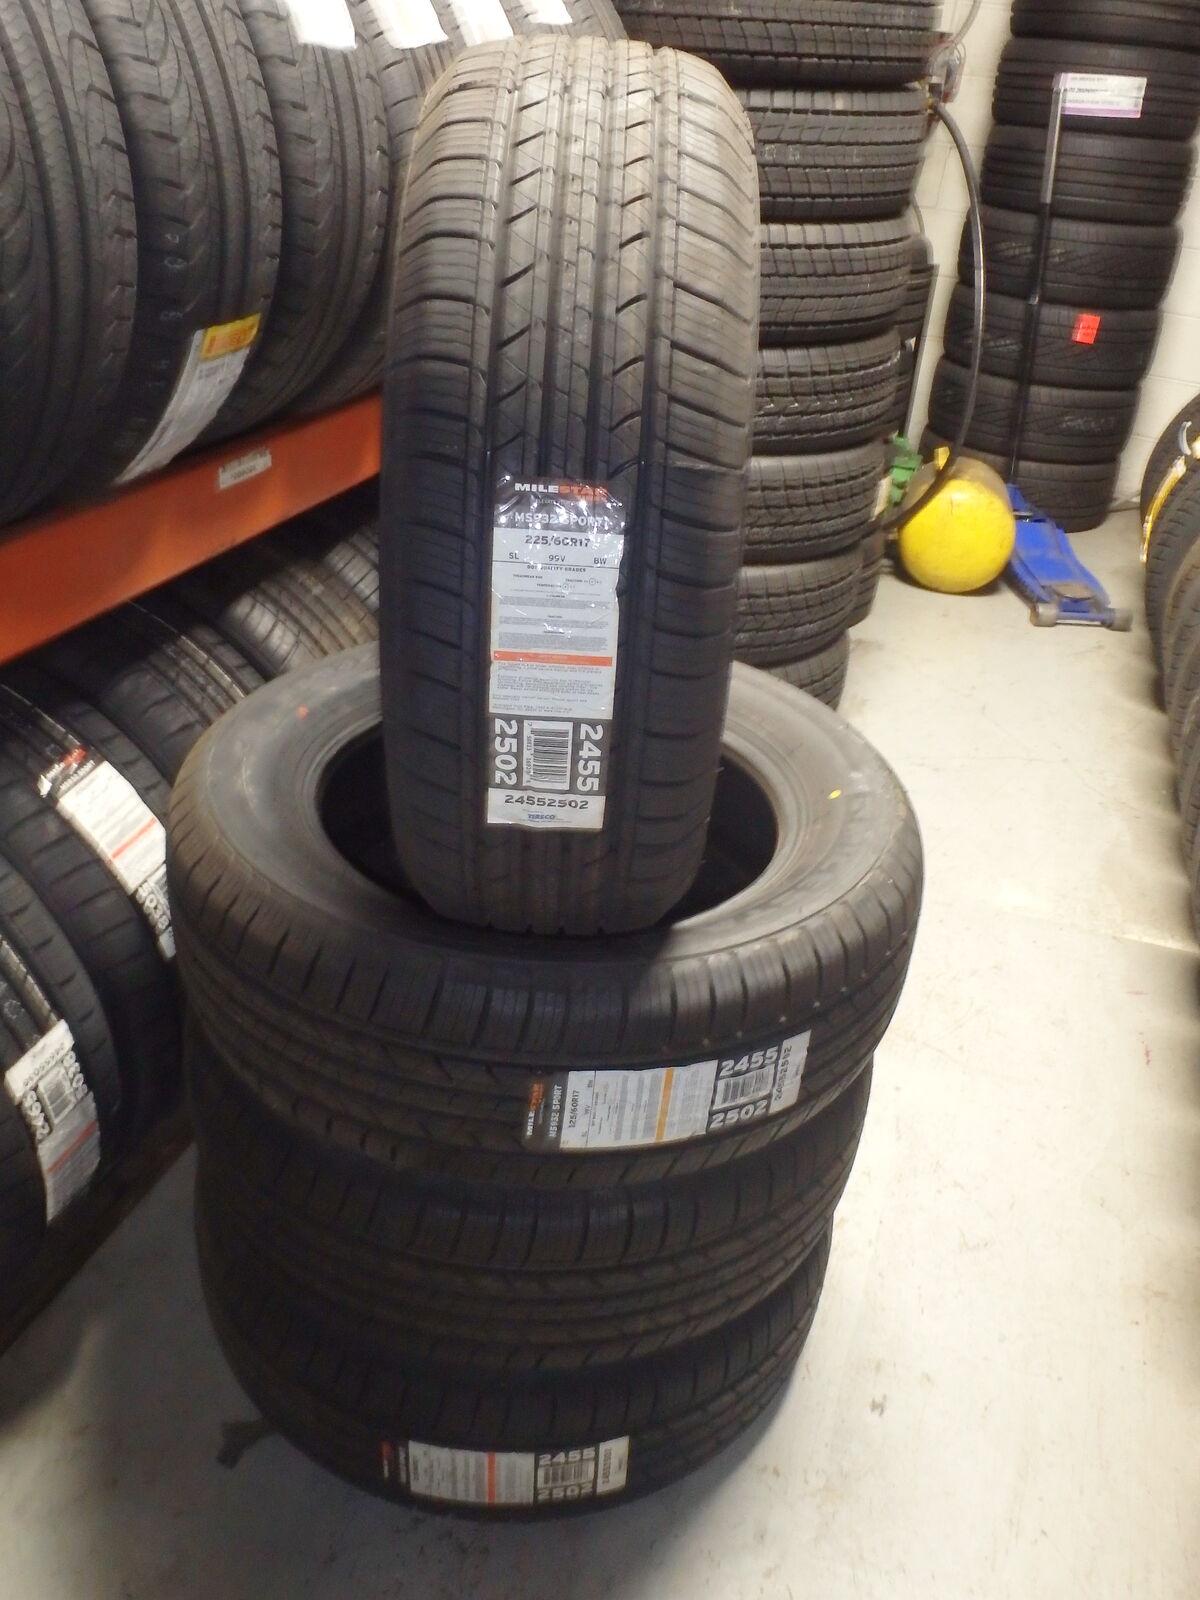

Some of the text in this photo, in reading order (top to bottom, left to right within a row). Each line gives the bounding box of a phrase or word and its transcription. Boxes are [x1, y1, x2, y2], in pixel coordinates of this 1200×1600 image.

[514, 482, 608, 503] MILESTAR
[525, 534, 591, 548] 225/60R17
[508, 552, 520, 560] SL
[593, 557, 607, 565] BW
[494, 718, 518, 786] 2502
[576, 723, 604, 792] 2455
[504, 794, 589, 810] 24552502
[720, 1046, 779, 1079] 2455
[552, 1084, 562, 1111] SPORT
[708, 1099, 769, 1130] 2502
